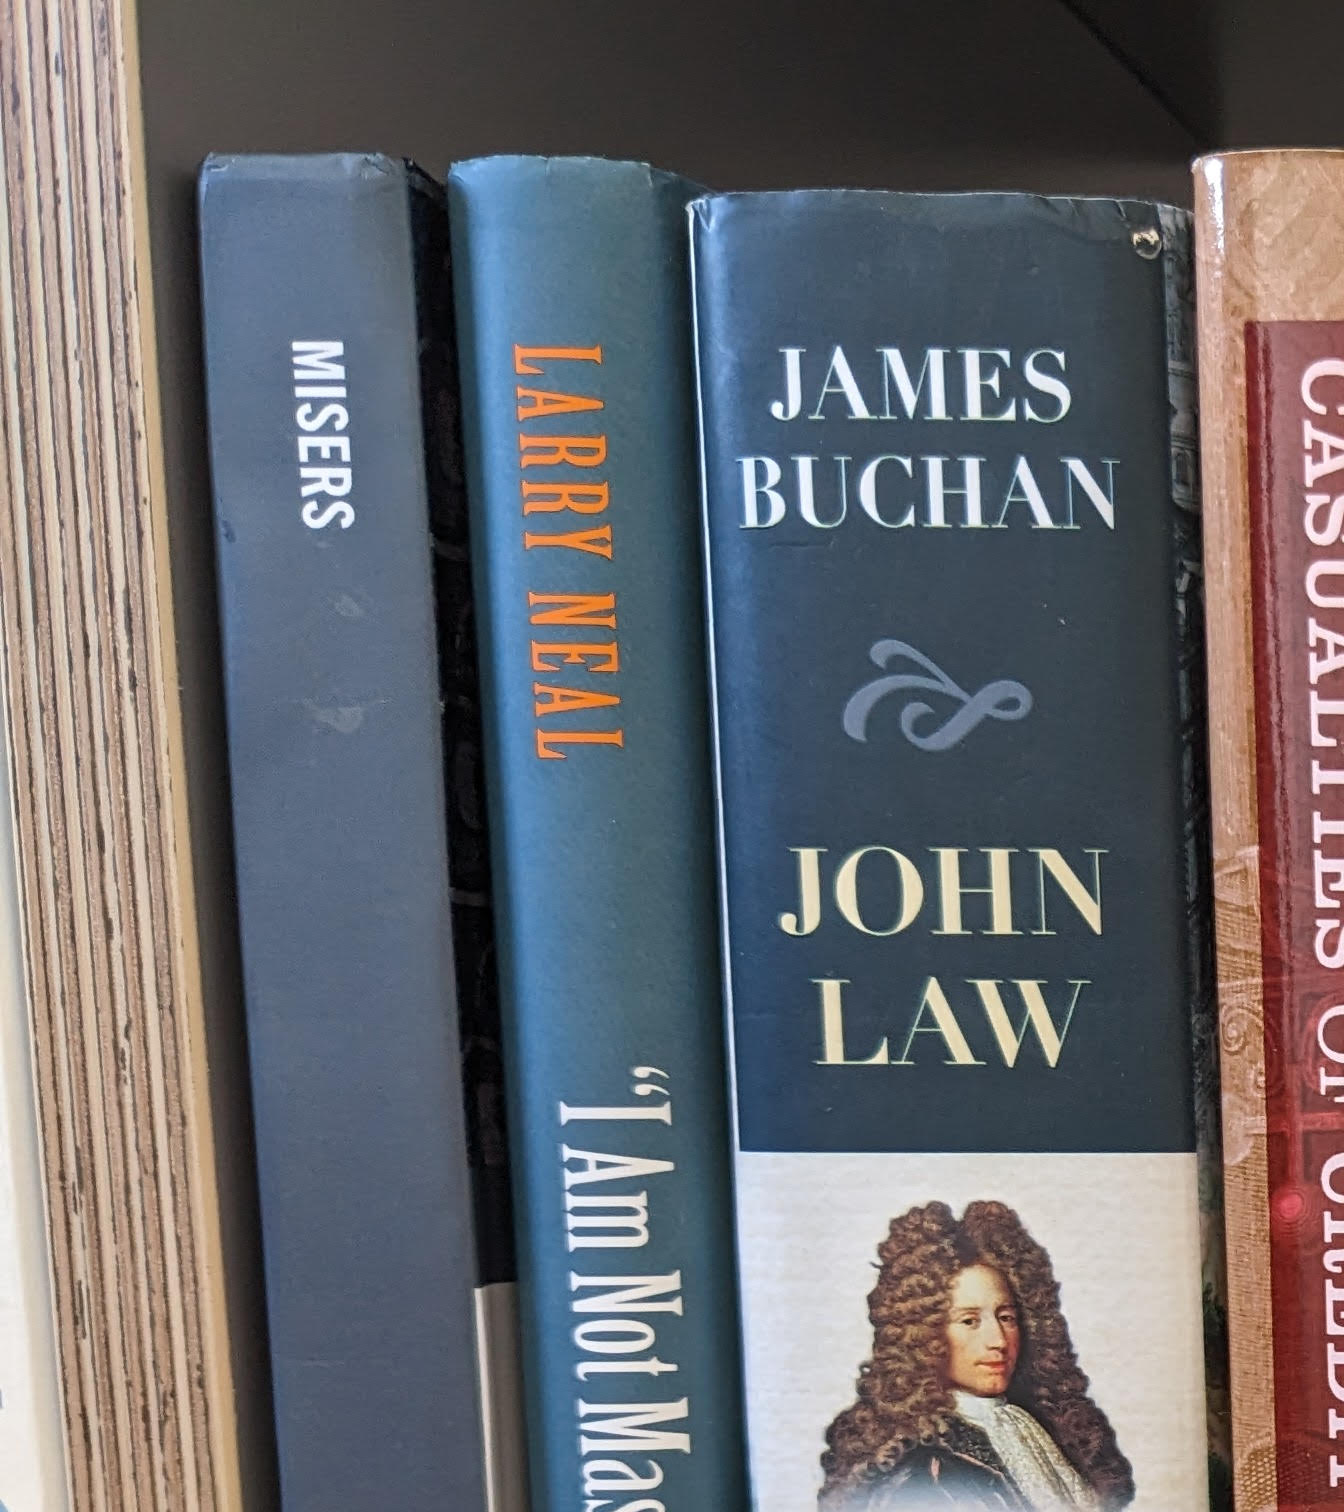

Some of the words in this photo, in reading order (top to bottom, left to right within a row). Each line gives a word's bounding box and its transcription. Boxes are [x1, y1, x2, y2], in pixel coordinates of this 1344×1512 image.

[291, 340, 354, 530] MISERS
[771, 345, 1071, 424] JAMES
[514, 343, 613, 560] LARRY
[738, 454, 1120, 531] BUCHAN
[528, 591, 624, 761] NEAL
[780, 847, 1109, 937] JOHN
[811, 976, 1092, 1069] LAW
[560, 1141, 675, 1254] Am
[568, 1268, 685, 1382] Not
